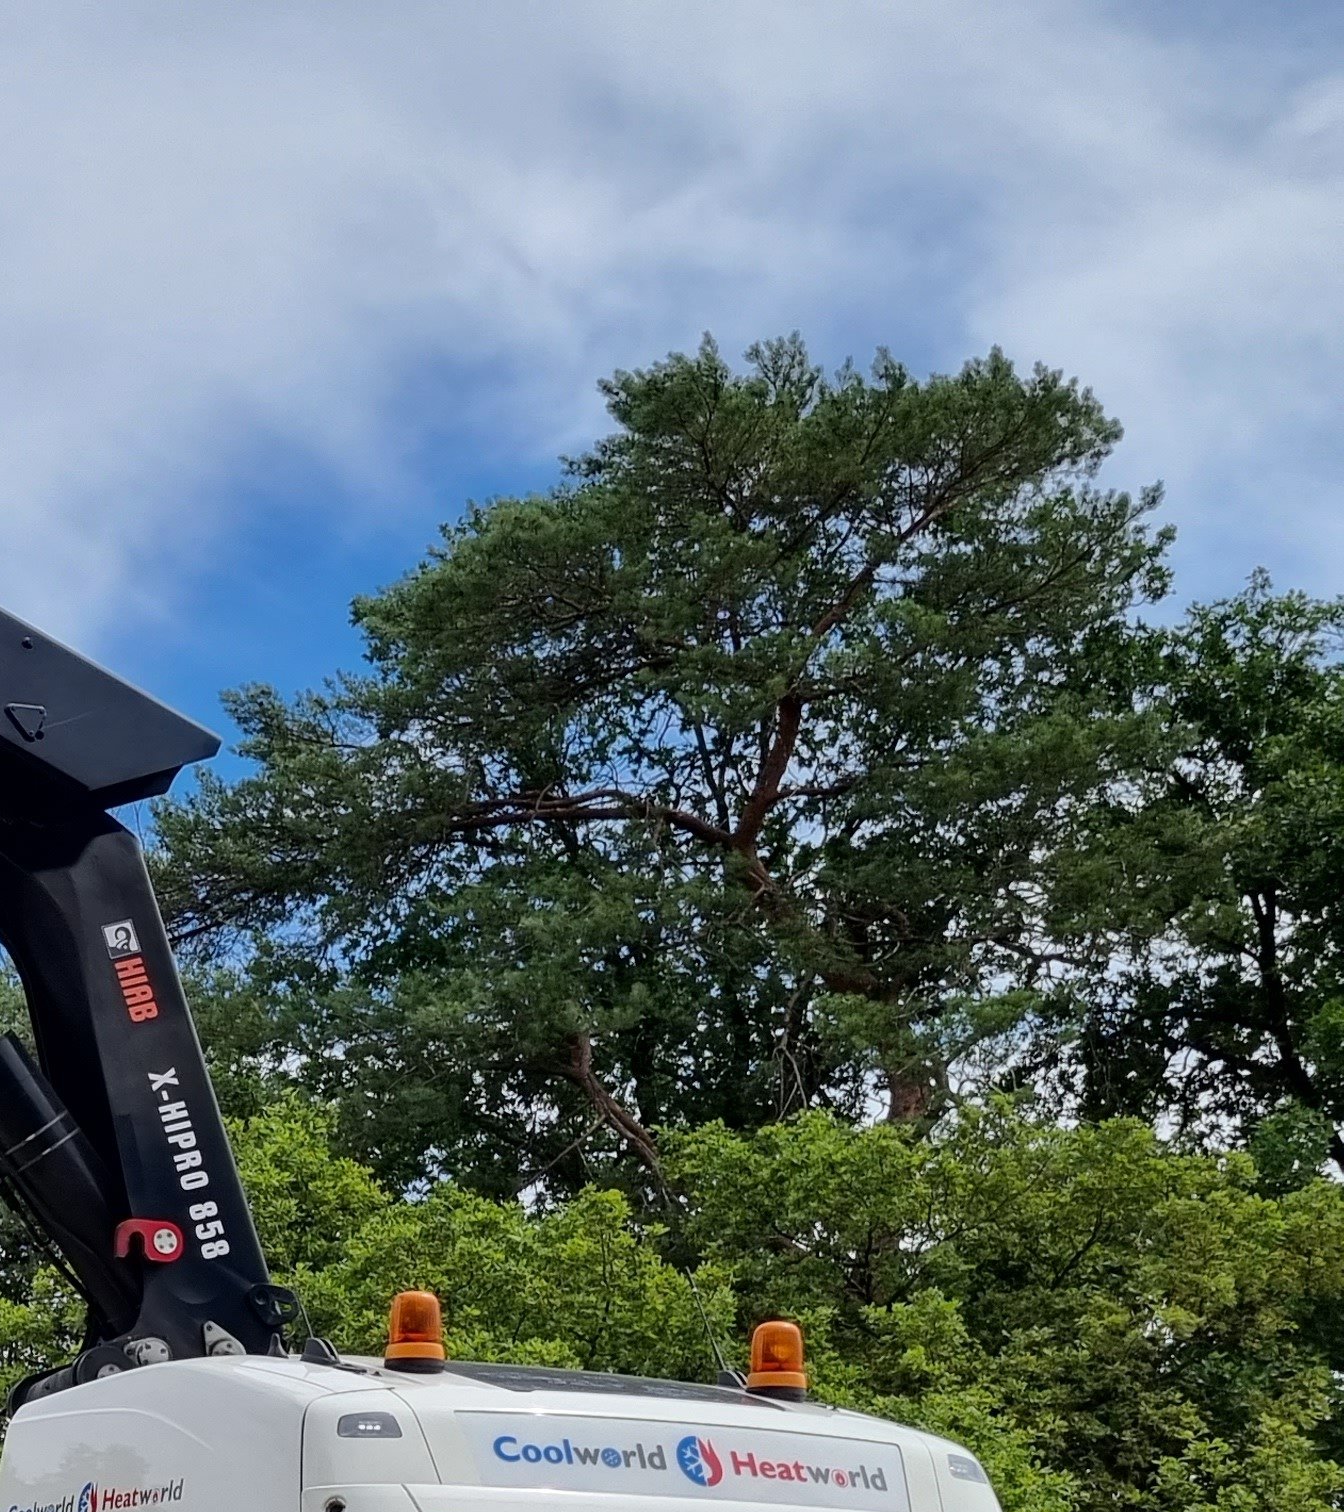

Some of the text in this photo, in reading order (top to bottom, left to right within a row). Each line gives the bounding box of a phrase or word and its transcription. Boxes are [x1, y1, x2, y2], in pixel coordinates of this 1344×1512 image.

[114, 957, 159, 1024] HIAB
[148, 1066, 230, 1260] X-HIPRO 858
[493, 1435, 889, 1491] Coolworld Heatworld
[102, 1478, 184, 1511] Heatworld
